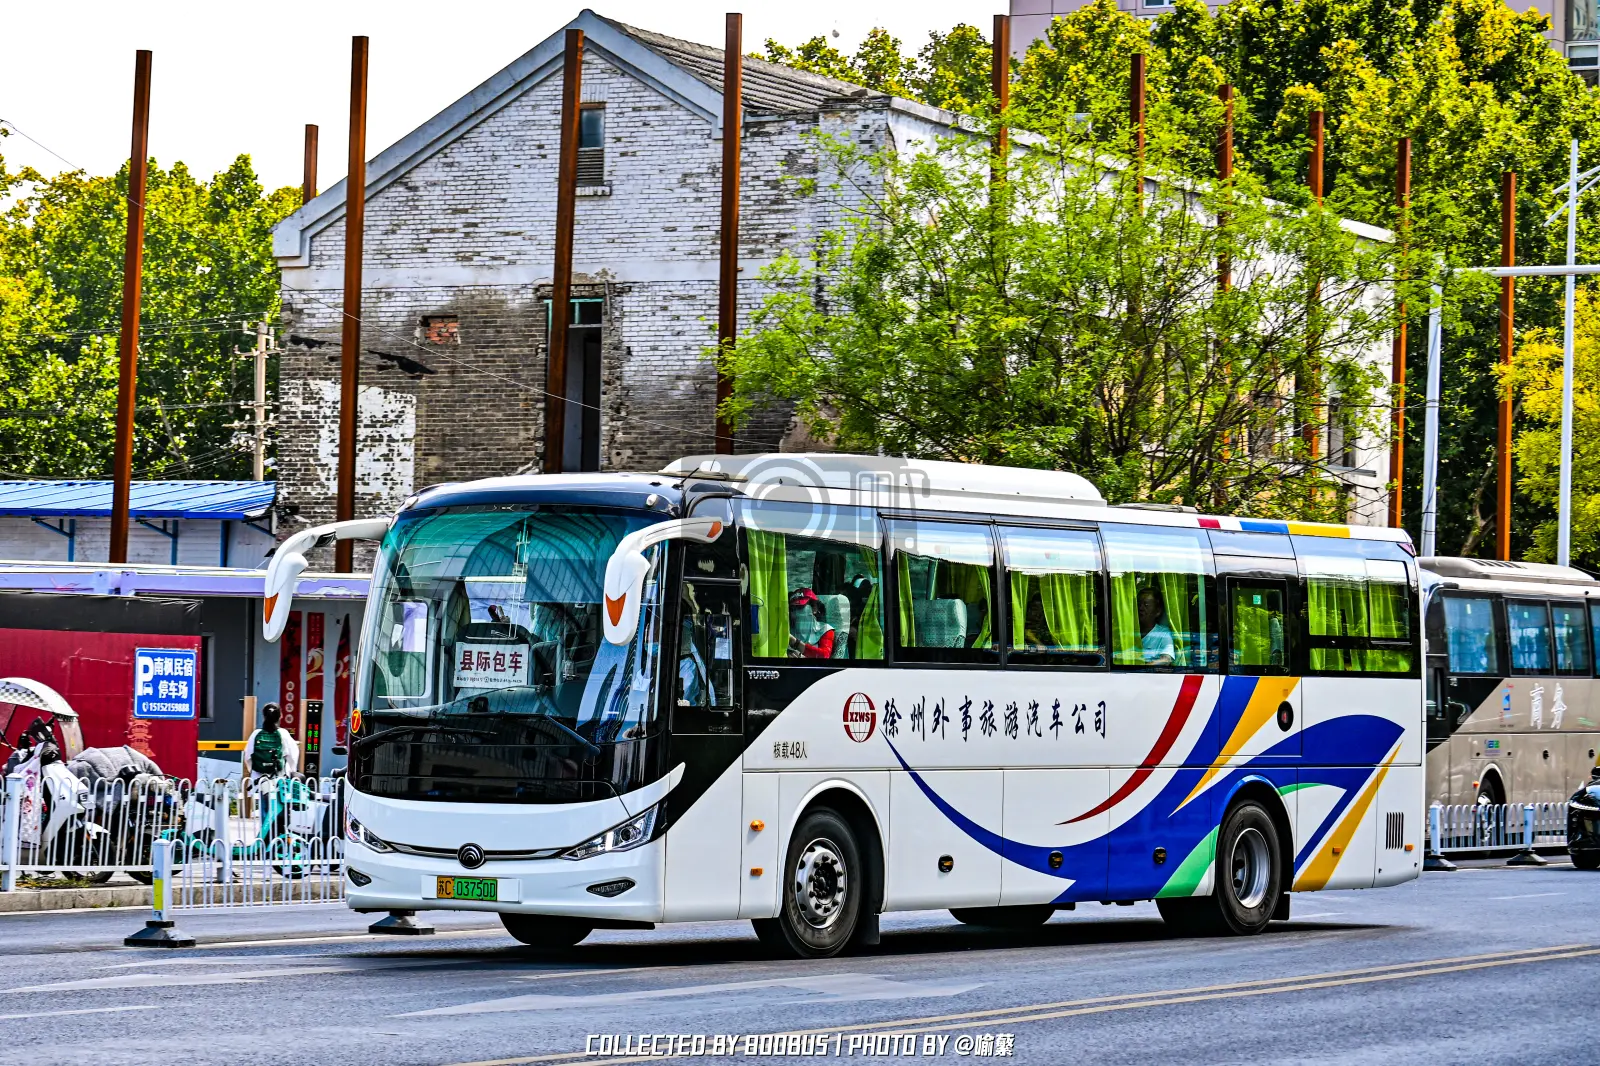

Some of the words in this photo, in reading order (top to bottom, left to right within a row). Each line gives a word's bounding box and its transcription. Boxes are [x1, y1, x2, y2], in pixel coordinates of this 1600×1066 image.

[153, 656, 194, 677] 南枫民宿
[459, 649, 523, 674] 县际包车
[137, 656, 154, 696] P
[158, 680, 189, 699] 停车场
[352, 712, 359, 728] 7
[849, 711, 871, 723] XZWS
[882, 695, 1107, 742] 徐州外事旅游汽车公司
[773, 741, 808, 759] 核载48人
